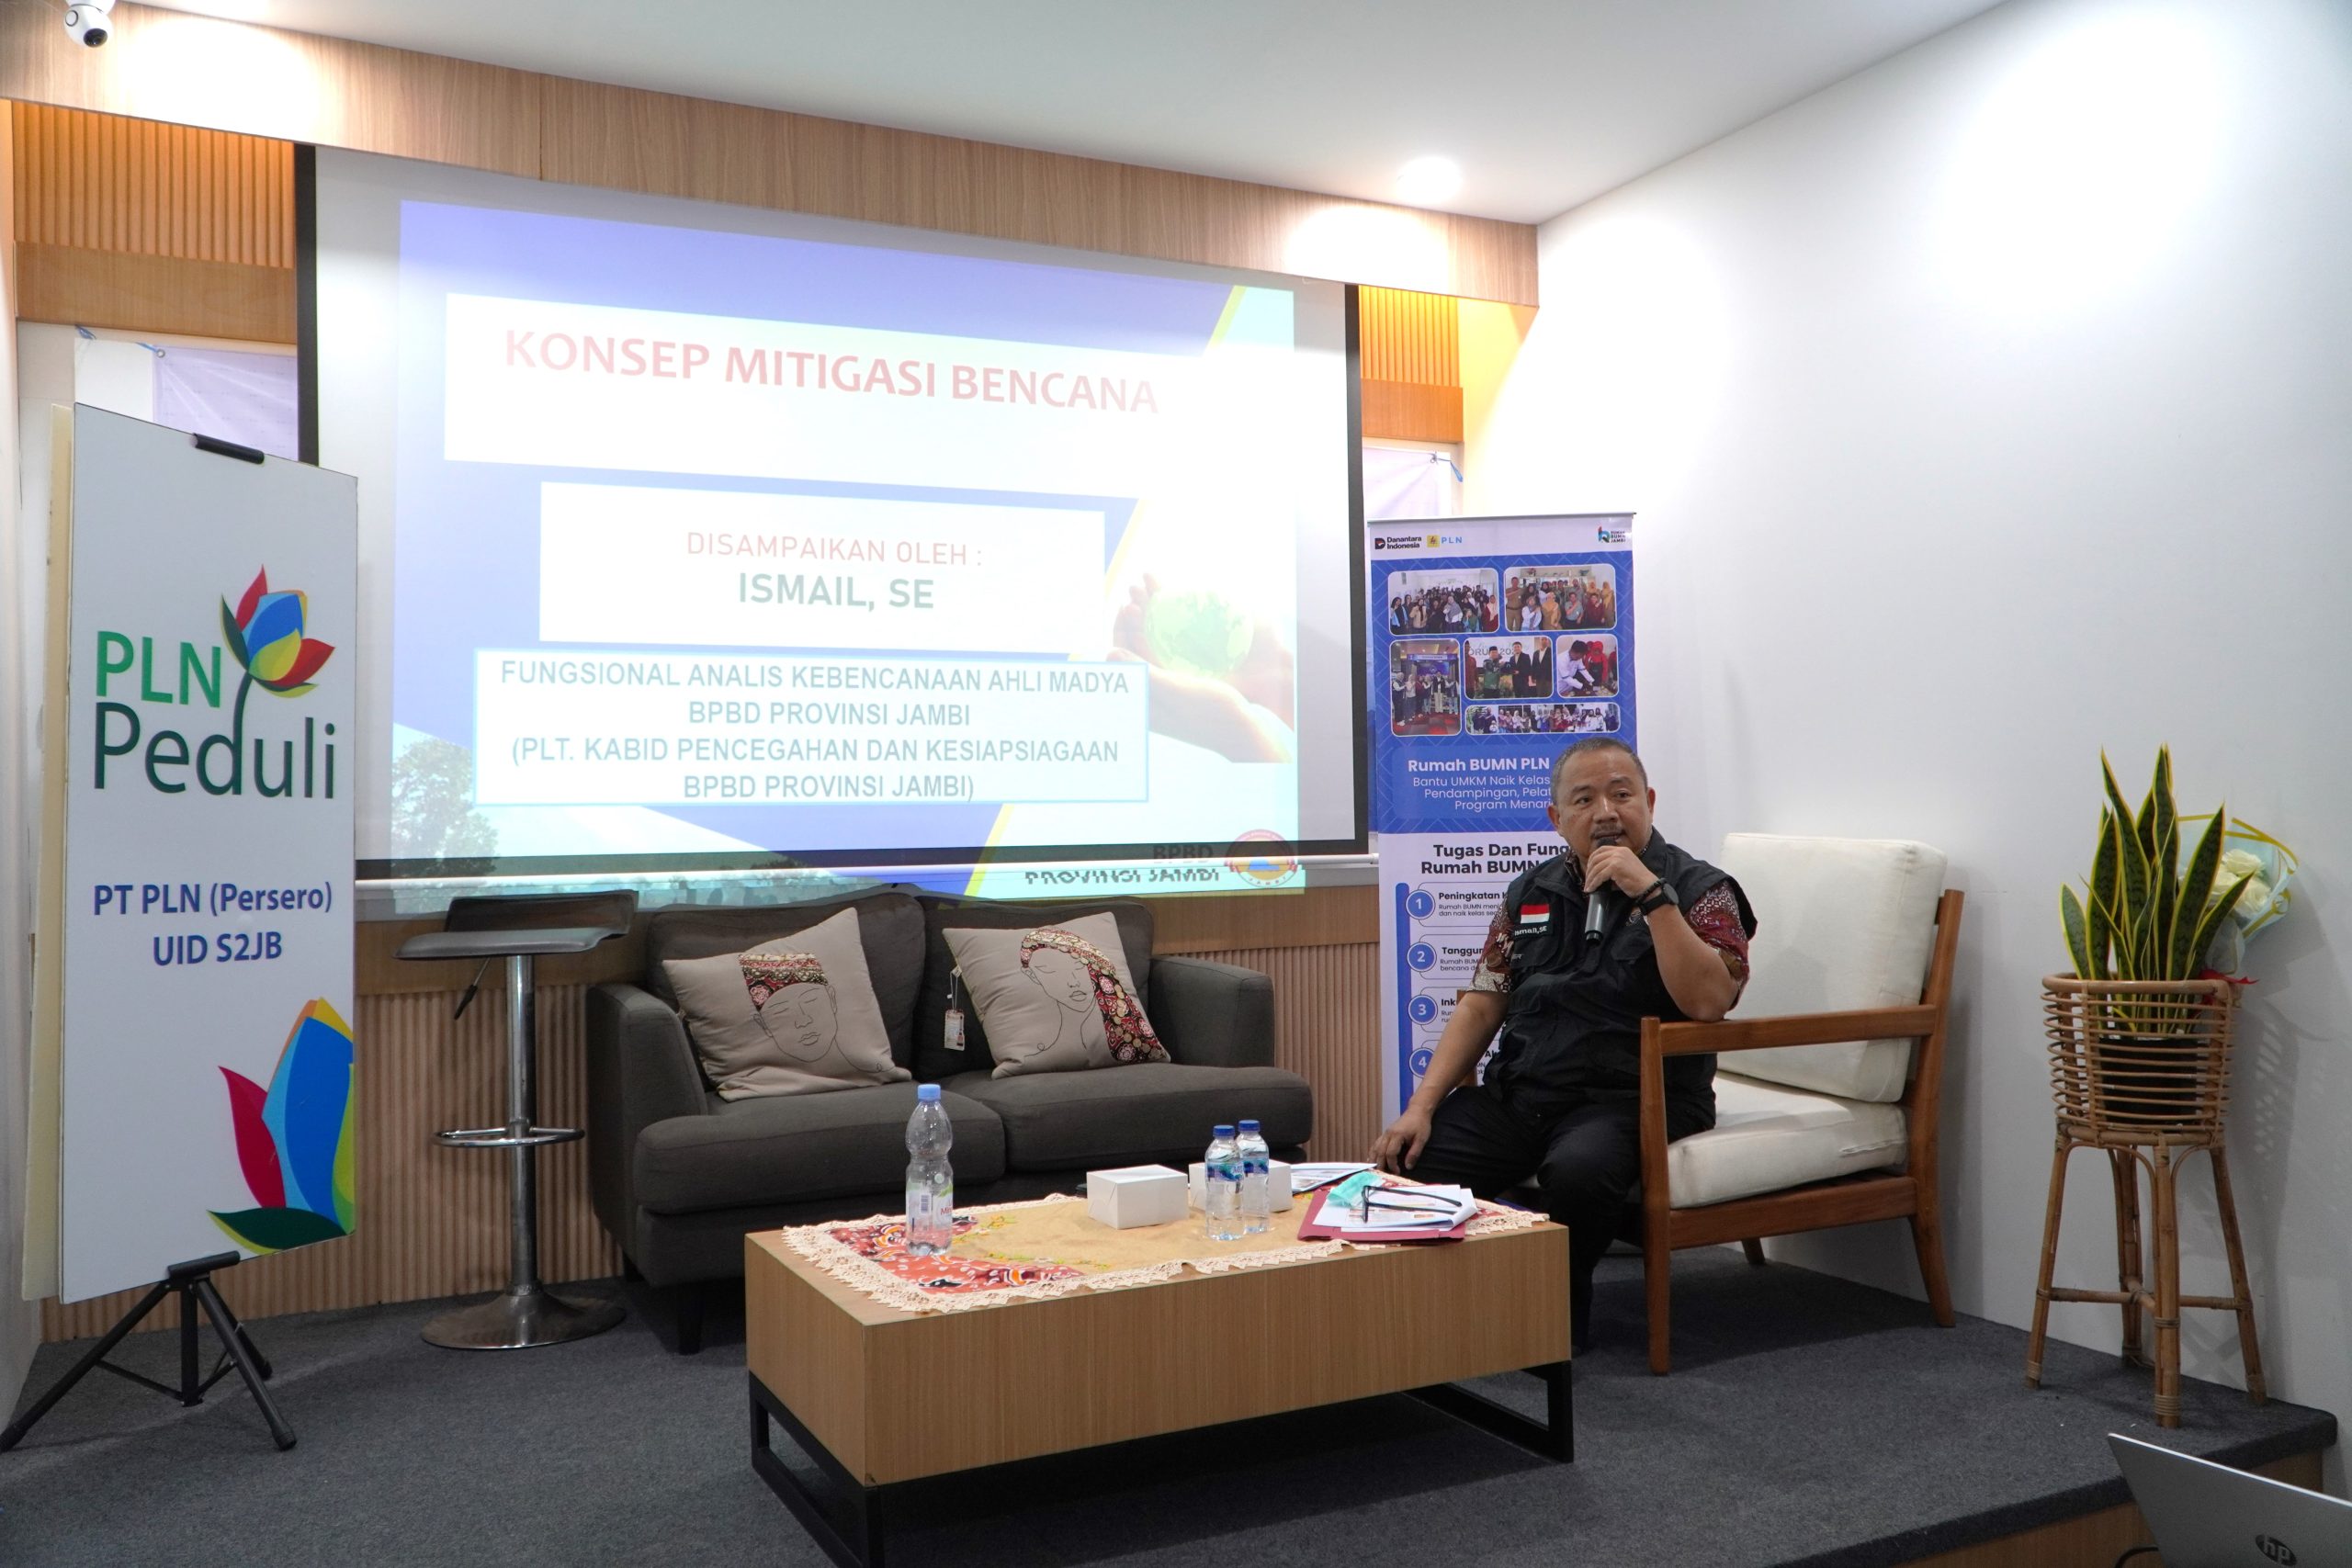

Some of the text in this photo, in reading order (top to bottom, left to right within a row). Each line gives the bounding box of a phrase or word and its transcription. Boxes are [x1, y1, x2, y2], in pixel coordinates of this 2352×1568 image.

[504, 330, 1160, 416] KONSEP MITIGASI BENCANA
[687, 530, 888, 566] DISAMPAIKAN
[896, 540, 967, 567] OLEH
[738, 572, 936, 613] ISMAIL, SE
[96, 630, 222, 709] PLN
[502, 660, 1131, 696] FUNGSIONAL ANALIS KEBENCANAAN AHLI MADYA
[688, 699, 971, 727] BPBD PROVINSI JAMBI
[94, 684, 336, 801] Peduli
[512, 735, 1121, 765] (PLT. KABID PENCEGAHAN DAN KESIAPSIAGAAN
[1408, 757, 1549, 773] Rumah BUMN PLN
[683, 773, 976, 802] BPBD PROVINSI JAMBI)
[1413, 775, 1551, 786] Bantu UMKM Naik Kelas
[1424, 787, 1551, 801] Pendampingan, Pelat
[1455, 799, 1551, 812] Program Menari
[1433, 842, 1569, 860] Tugas Dan Fung
[1421, 860, 1539, 874] Rumah BUMN
[94, 879, 334, 918] PT PLN (Persero)
[1416, 897, 1422, 909] 1
[1439, 891, 1500, 902] Peningkatan
[153, 929, 284, 966] UID S2JB
[1417, 950, 1425, 962] 2
[1419, 1004, 1427, 1016] 3
[2263, 1535, 2290, 1565] hp
